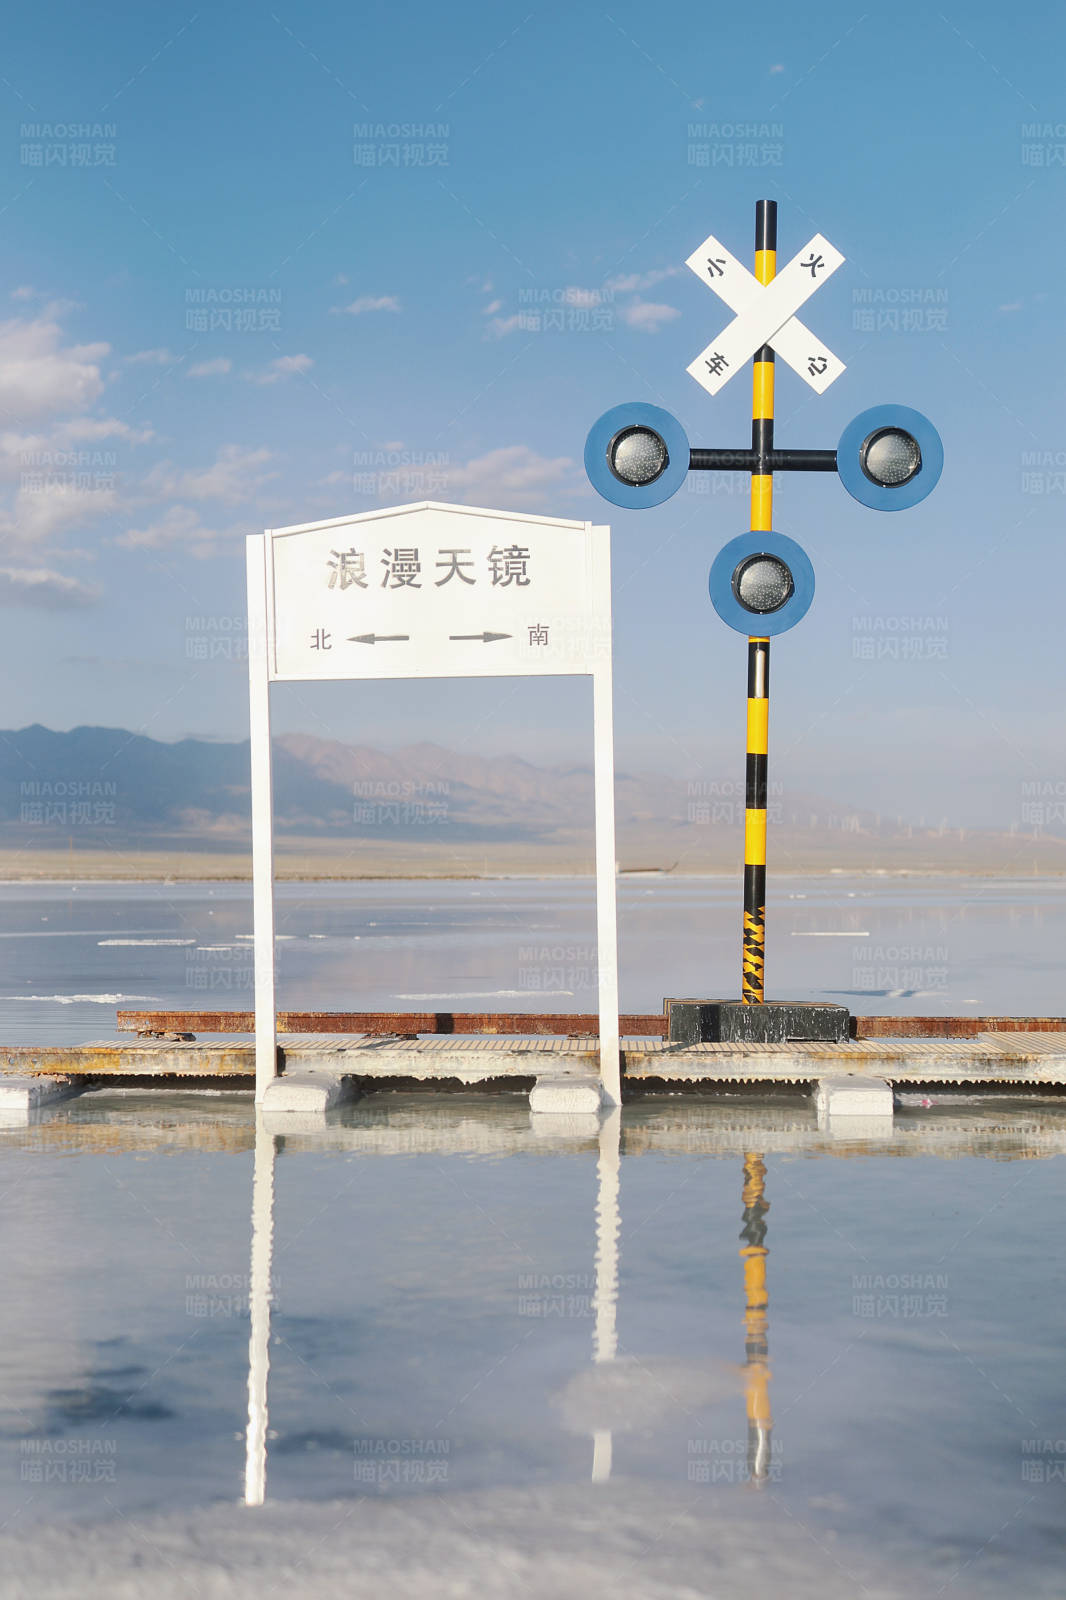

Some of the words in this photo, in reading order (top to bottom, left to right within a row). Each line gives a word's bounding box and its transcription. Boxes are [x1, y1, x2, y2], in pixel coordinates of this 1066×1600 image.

[800, 253, 825, 278] 火
[706, 258, 727, 278] 小
[807, 356, 828, 377] 心
[704, 352, 730, 377] 车
[326, 544, 532, 591] 浪漫天镜
[310, 628, 332, 650] 北
[528, 623, 550, 646] 南
